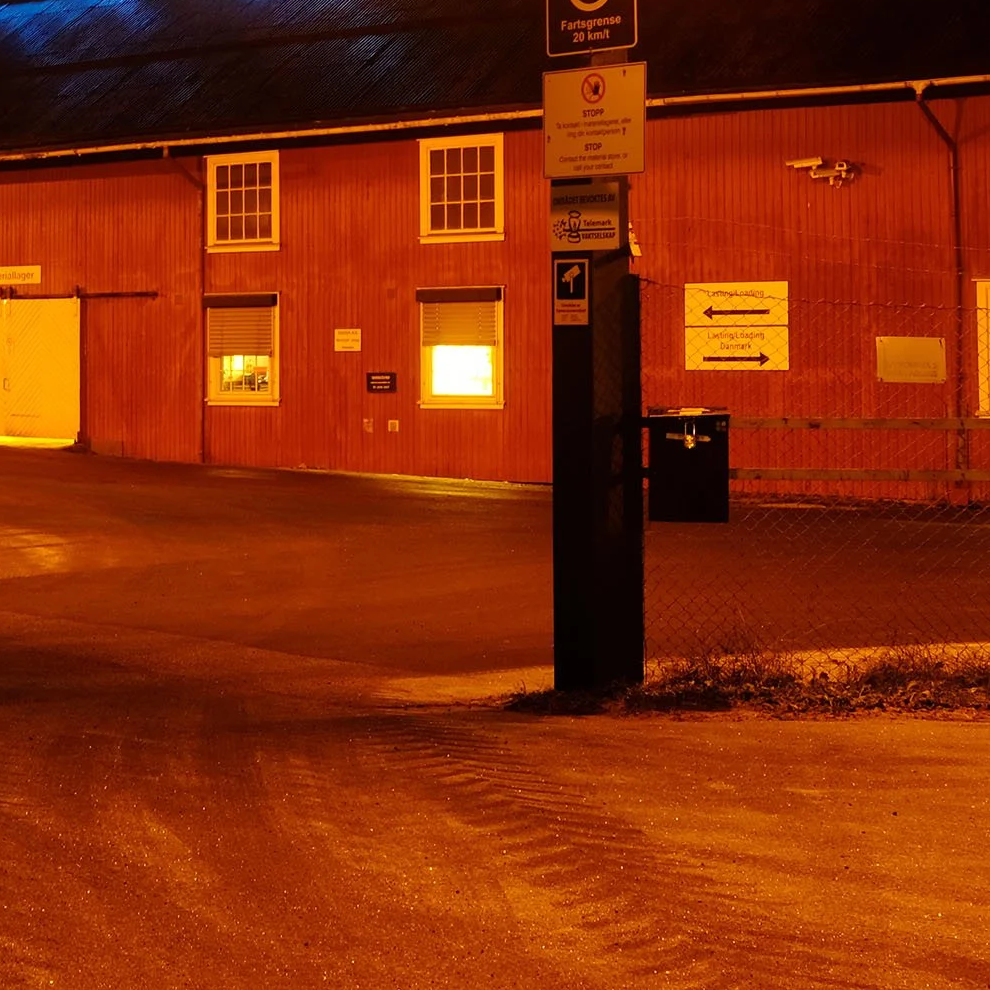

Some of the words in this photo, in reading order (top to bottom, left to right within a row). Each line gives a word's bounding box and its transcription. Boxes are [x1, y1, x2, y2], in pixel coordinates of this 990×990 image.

[561, 14, 622, 31] Fartsgrense
[572, 31, 585, 43] 20
[587, 28, 610, 41] km/t
[582, 107, 605, 118] STOPP
[584, 142, 603, 151] STOP
[583, 218, 612, 227] Telemark
[707, 331, 765, 341] Lasting/Loading
[720, 342, 753, 351] Danmark
